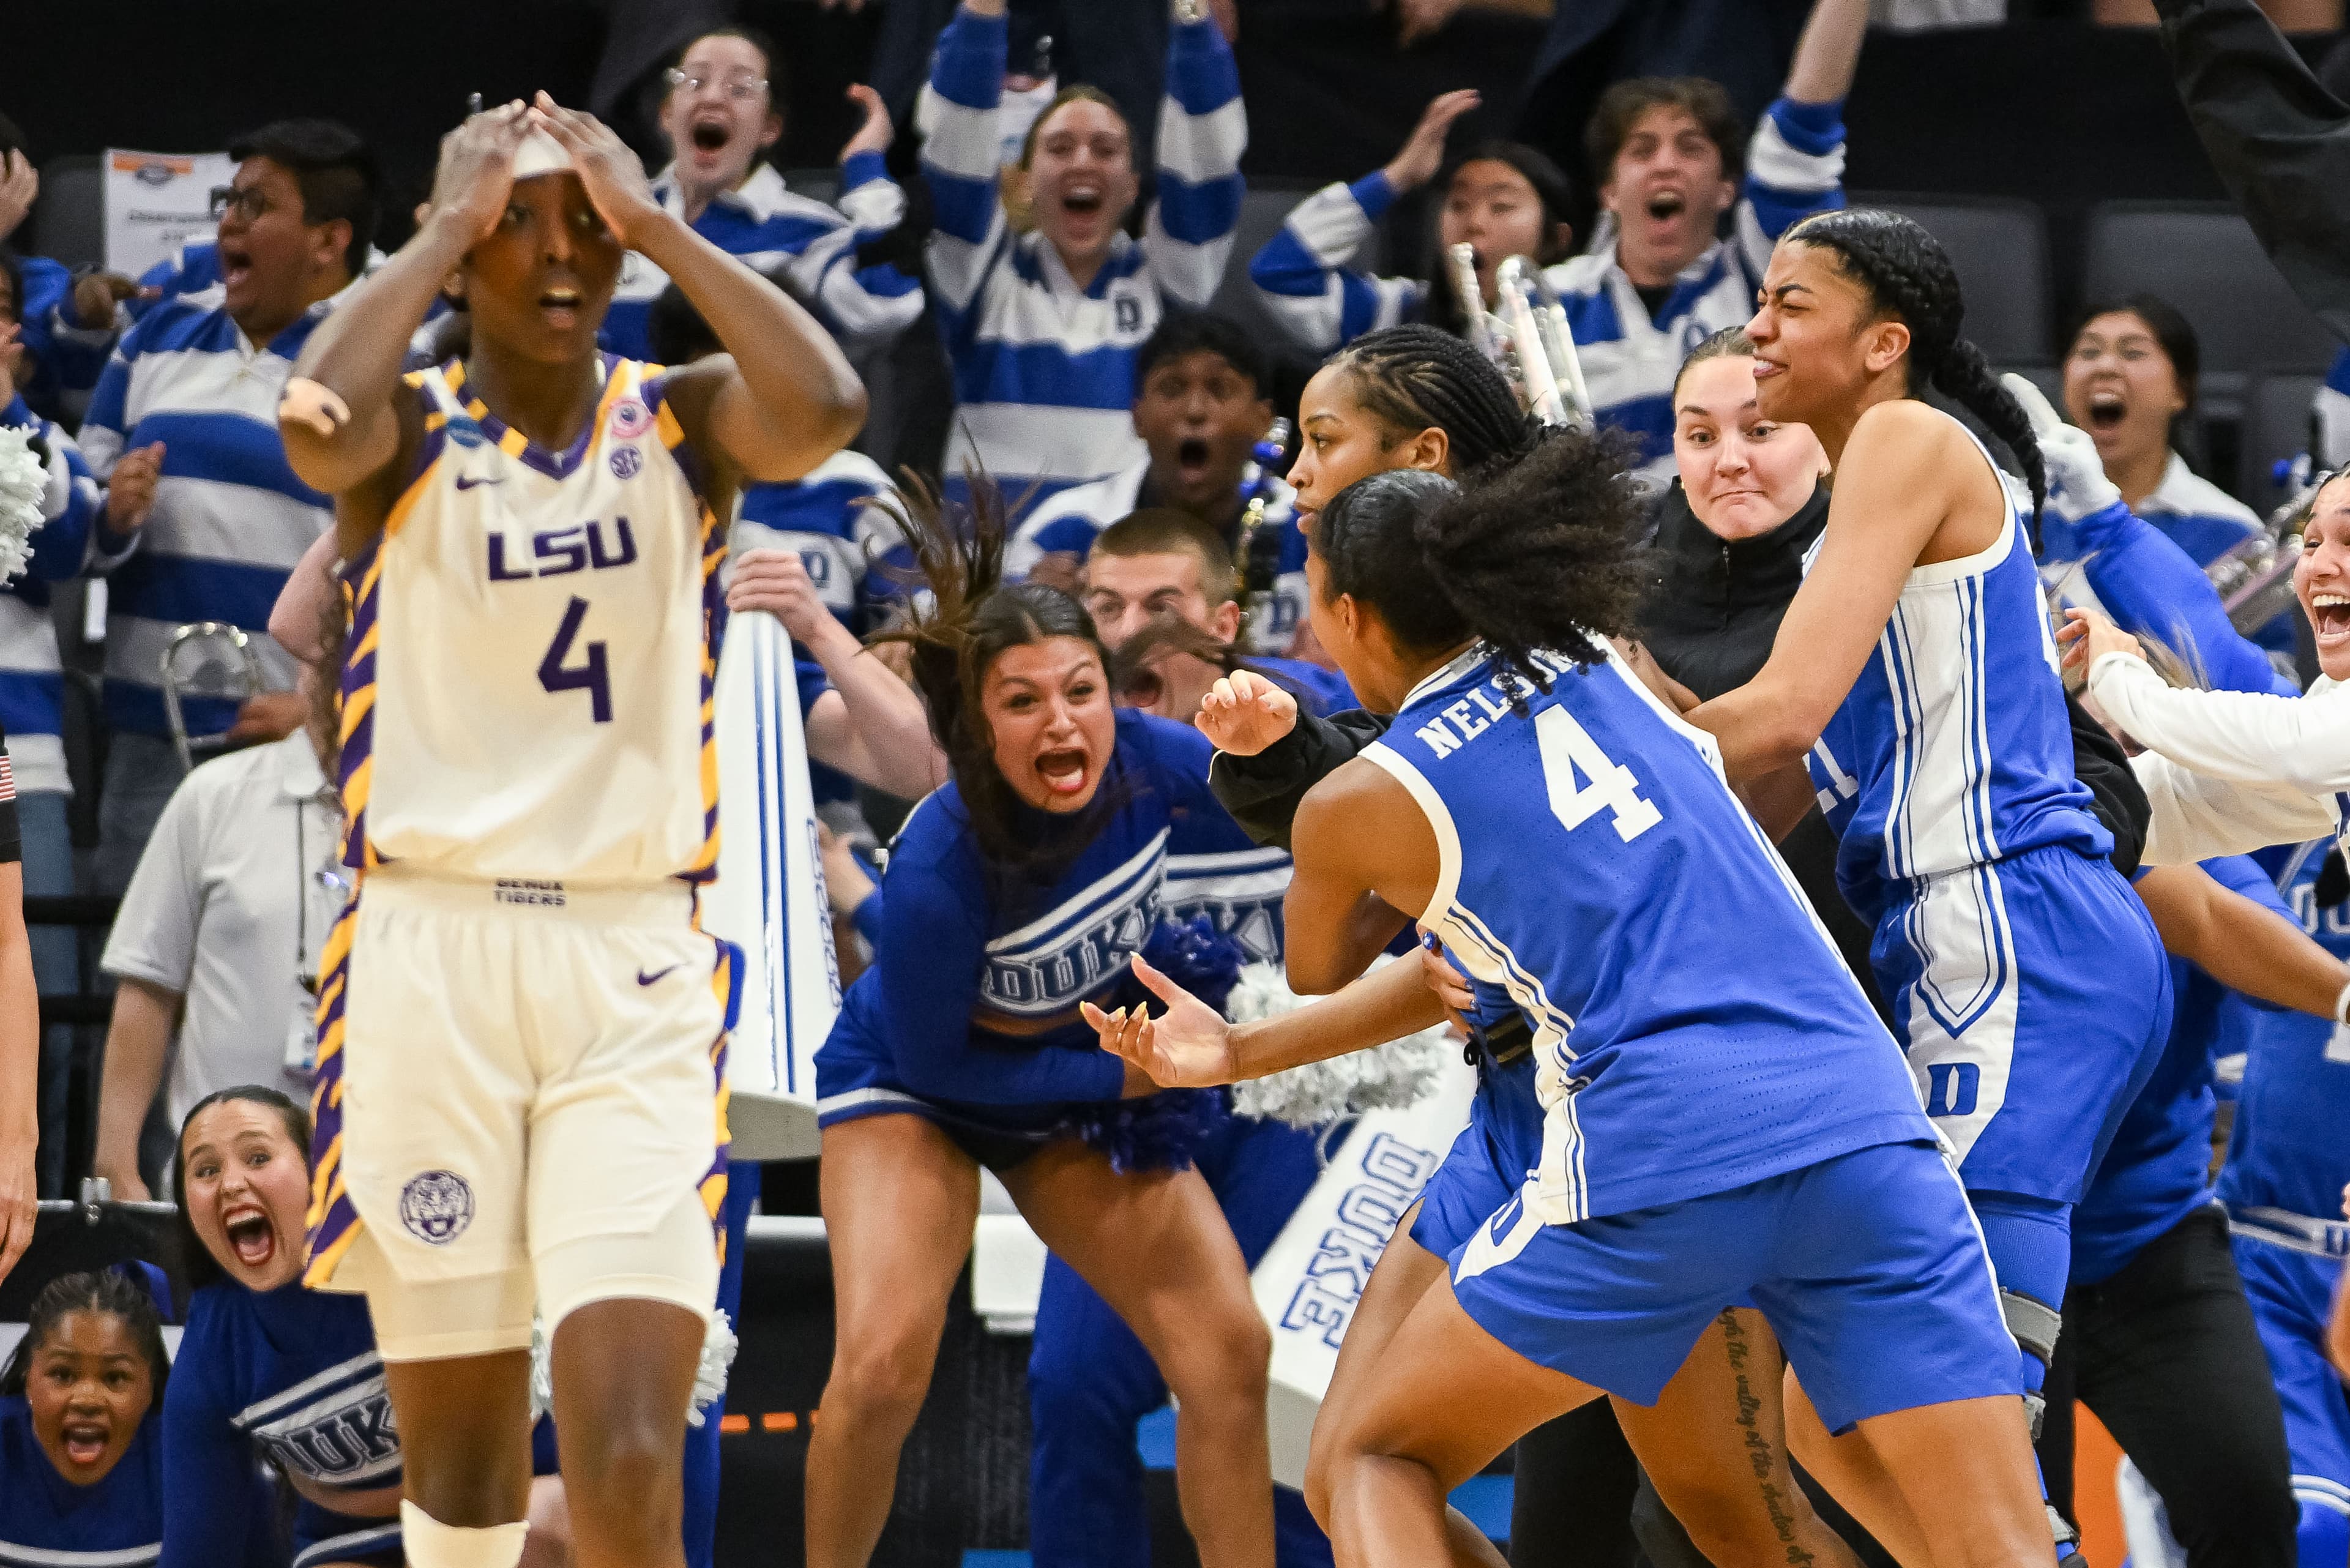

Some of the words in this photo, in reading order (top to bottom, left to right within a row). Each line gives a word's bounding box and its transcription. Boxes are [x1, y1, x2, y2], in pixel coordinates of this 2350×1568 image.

[488, 517, 636, 581] LSU
[538, 594, 613, 721] 4
[1534, 703, 1663, 843] 4
[494, 889, 565, 906] TIGERS
[1925, 1062, 1980, 1118] D
[1278, 1130, 1439, 1350] DUKE
